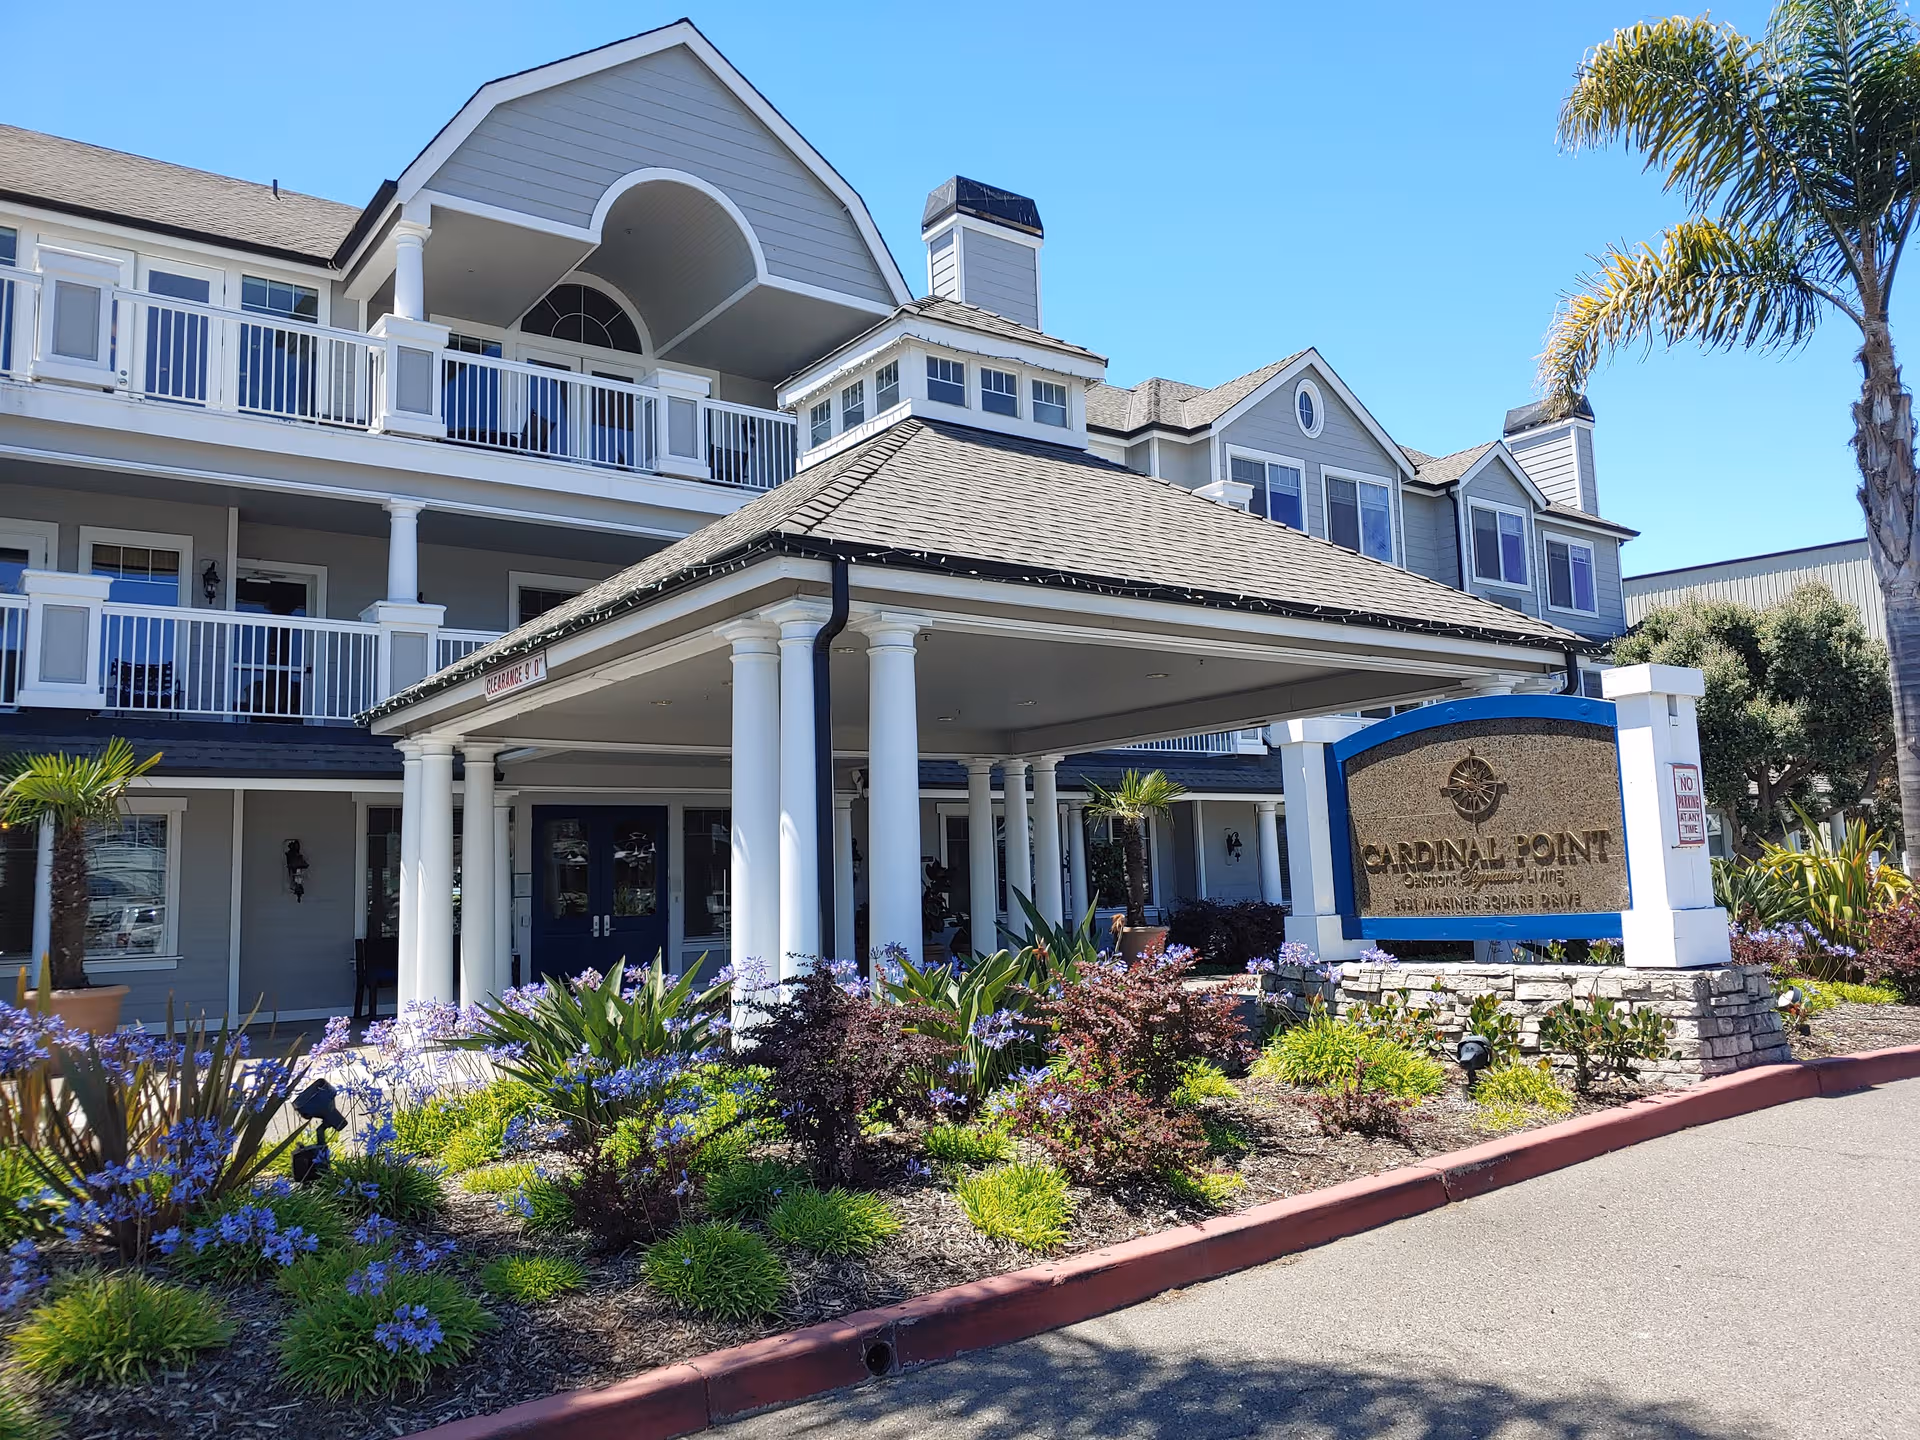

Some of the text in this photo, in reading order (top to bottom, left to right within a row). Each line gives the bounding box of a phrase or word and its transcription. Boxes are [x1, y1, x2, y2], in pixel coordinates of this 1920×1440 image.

[486, 666, 522, 695] CLEARANCE
[1680, 777, 1693, 791] NO
[1677, 795, 1700, 809] PARKING
[1680, 813, 1700, 822] AT ANY
[1684, 825, 1699, 834] TIME
[1361, 828, 1611, 872] CARDINAL POINT
[1460, 861, 1524, 892] Signature
[1424, 895, 1478, 911] MARINER
[1484, 893, 1534, 911] SQUARE
[1540, 891, 1582, 908] DRIVE
